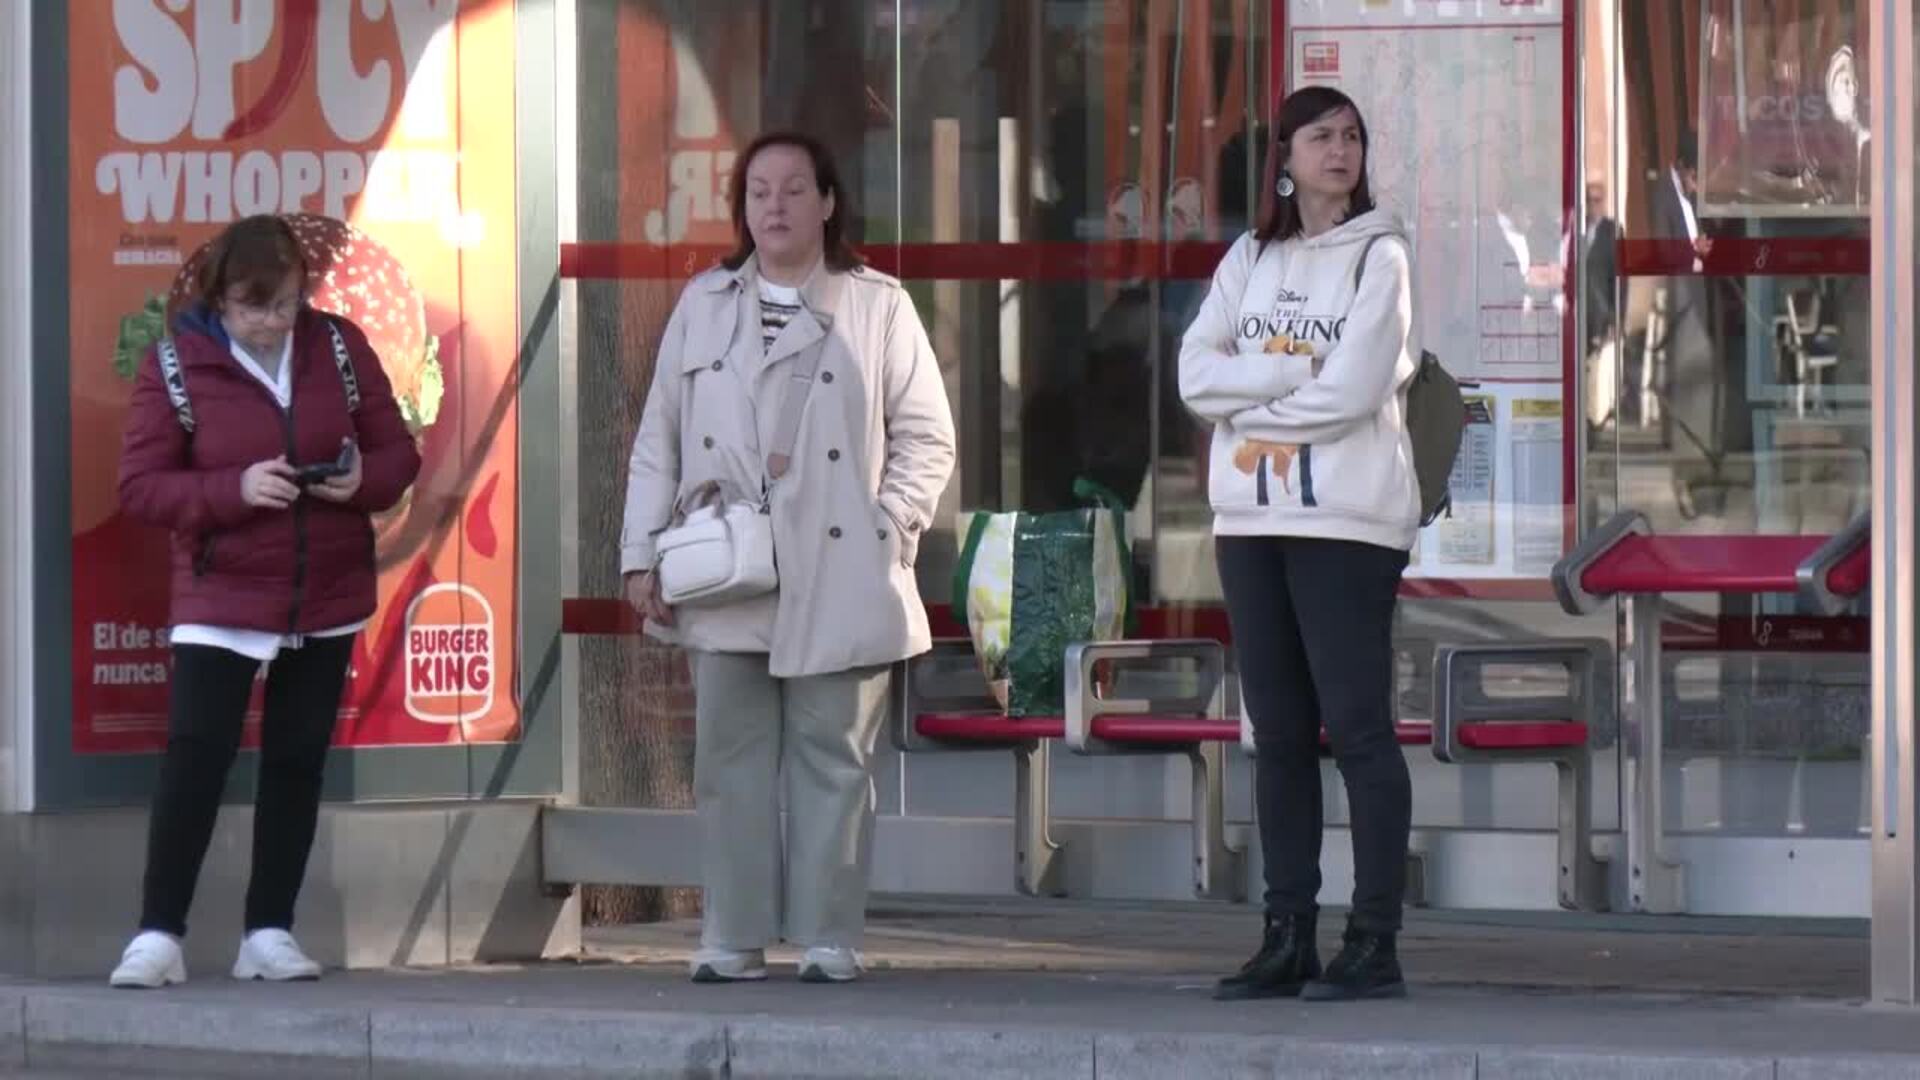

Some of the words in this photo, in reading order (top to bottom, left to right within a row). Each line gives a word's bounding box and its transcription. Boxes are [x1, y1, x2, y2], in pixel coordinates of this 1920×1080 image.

[94, 623, 117, 649] El
[121, 622, 151, 649] de
[410, 628, 489, 655] BURGER
[93, 661, 168, 685] nunca
[410, 654, 490, 693] KING
